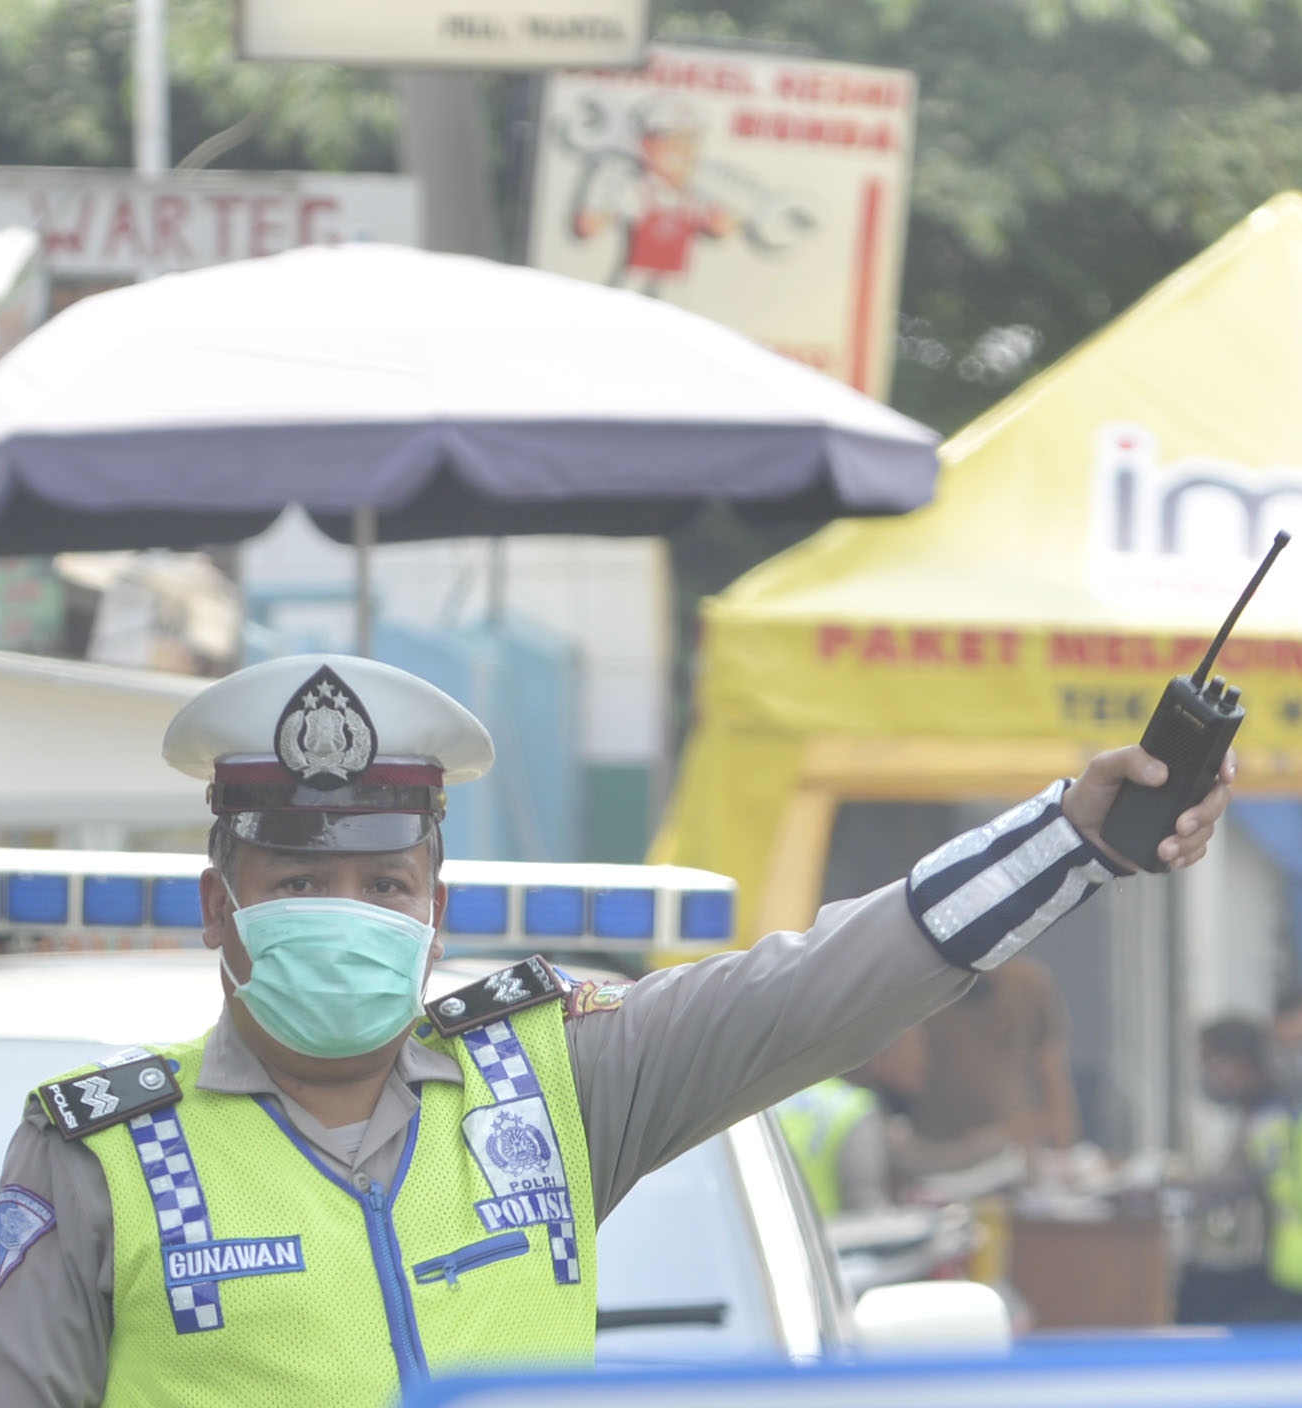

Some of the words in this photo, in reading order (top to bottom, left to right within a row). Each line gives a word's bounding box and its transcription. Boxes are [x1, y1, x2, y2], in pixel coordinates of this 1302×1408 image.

[816, 624, 1022, 666] PAKET
[48, 1084, 79, 1129] POLISI
[509, 1176, 556, 1192] POLRI
[478, 1191, 571, 1230] POLISI
[169, 1241, 297, 1279] GUNAWAN
